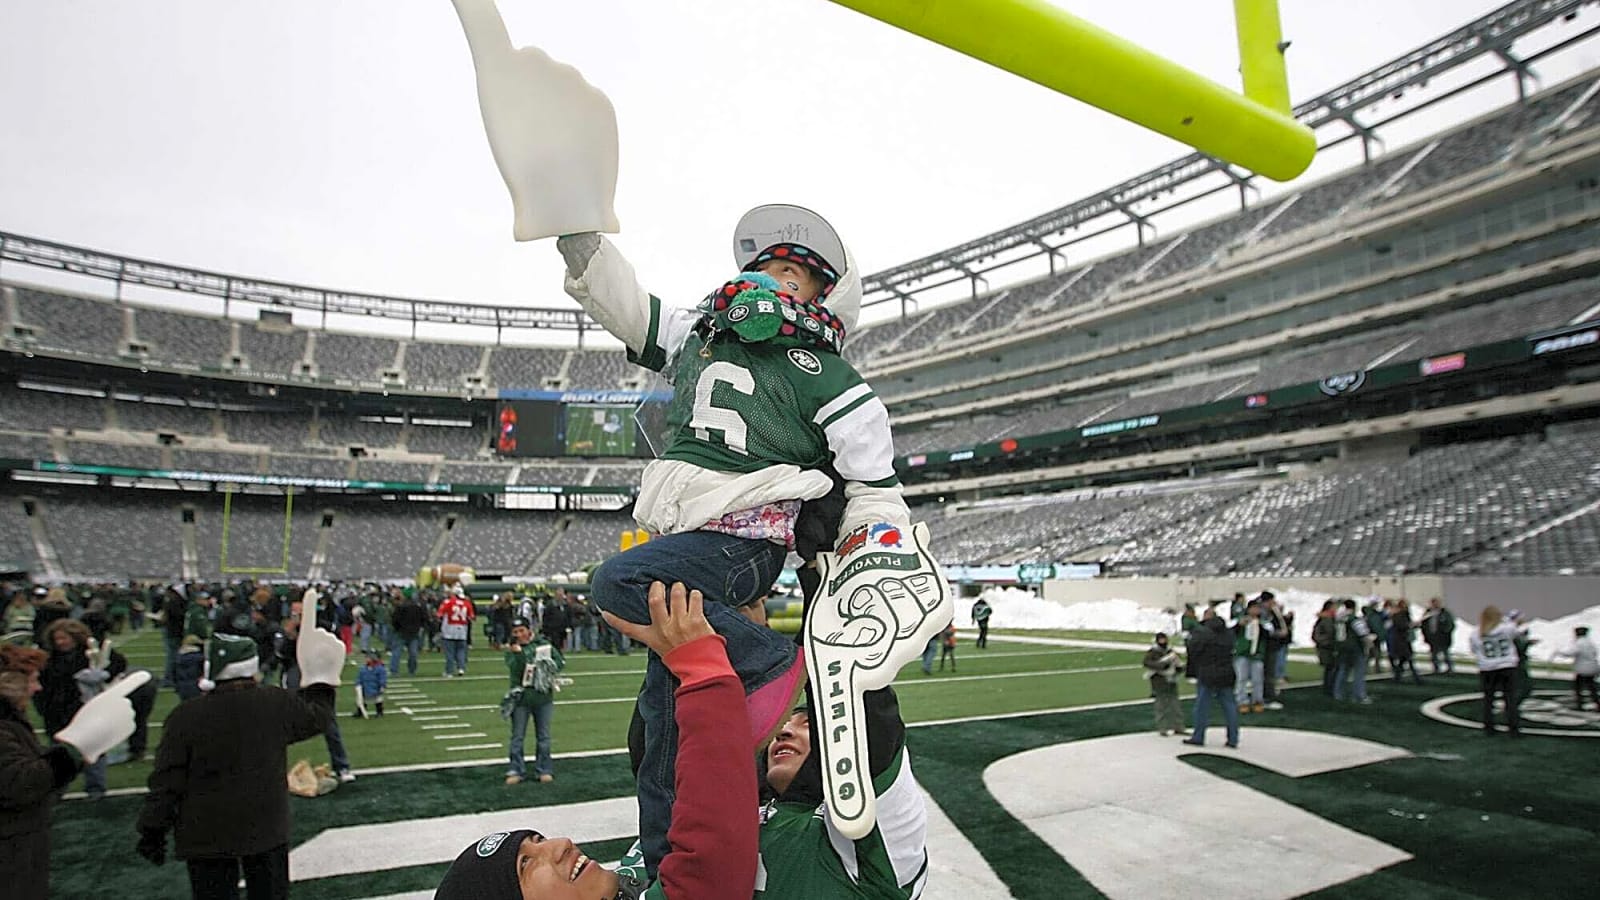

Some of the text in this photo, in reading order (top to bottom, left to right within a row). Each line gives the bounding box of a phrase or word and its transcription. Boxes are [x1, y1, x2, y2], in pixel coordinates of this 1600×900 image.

[837, 556, 901, 585] PLAYOFFS
[451, 605, 468, 621] 24
[827, 660, 855, 800] GO JETS
